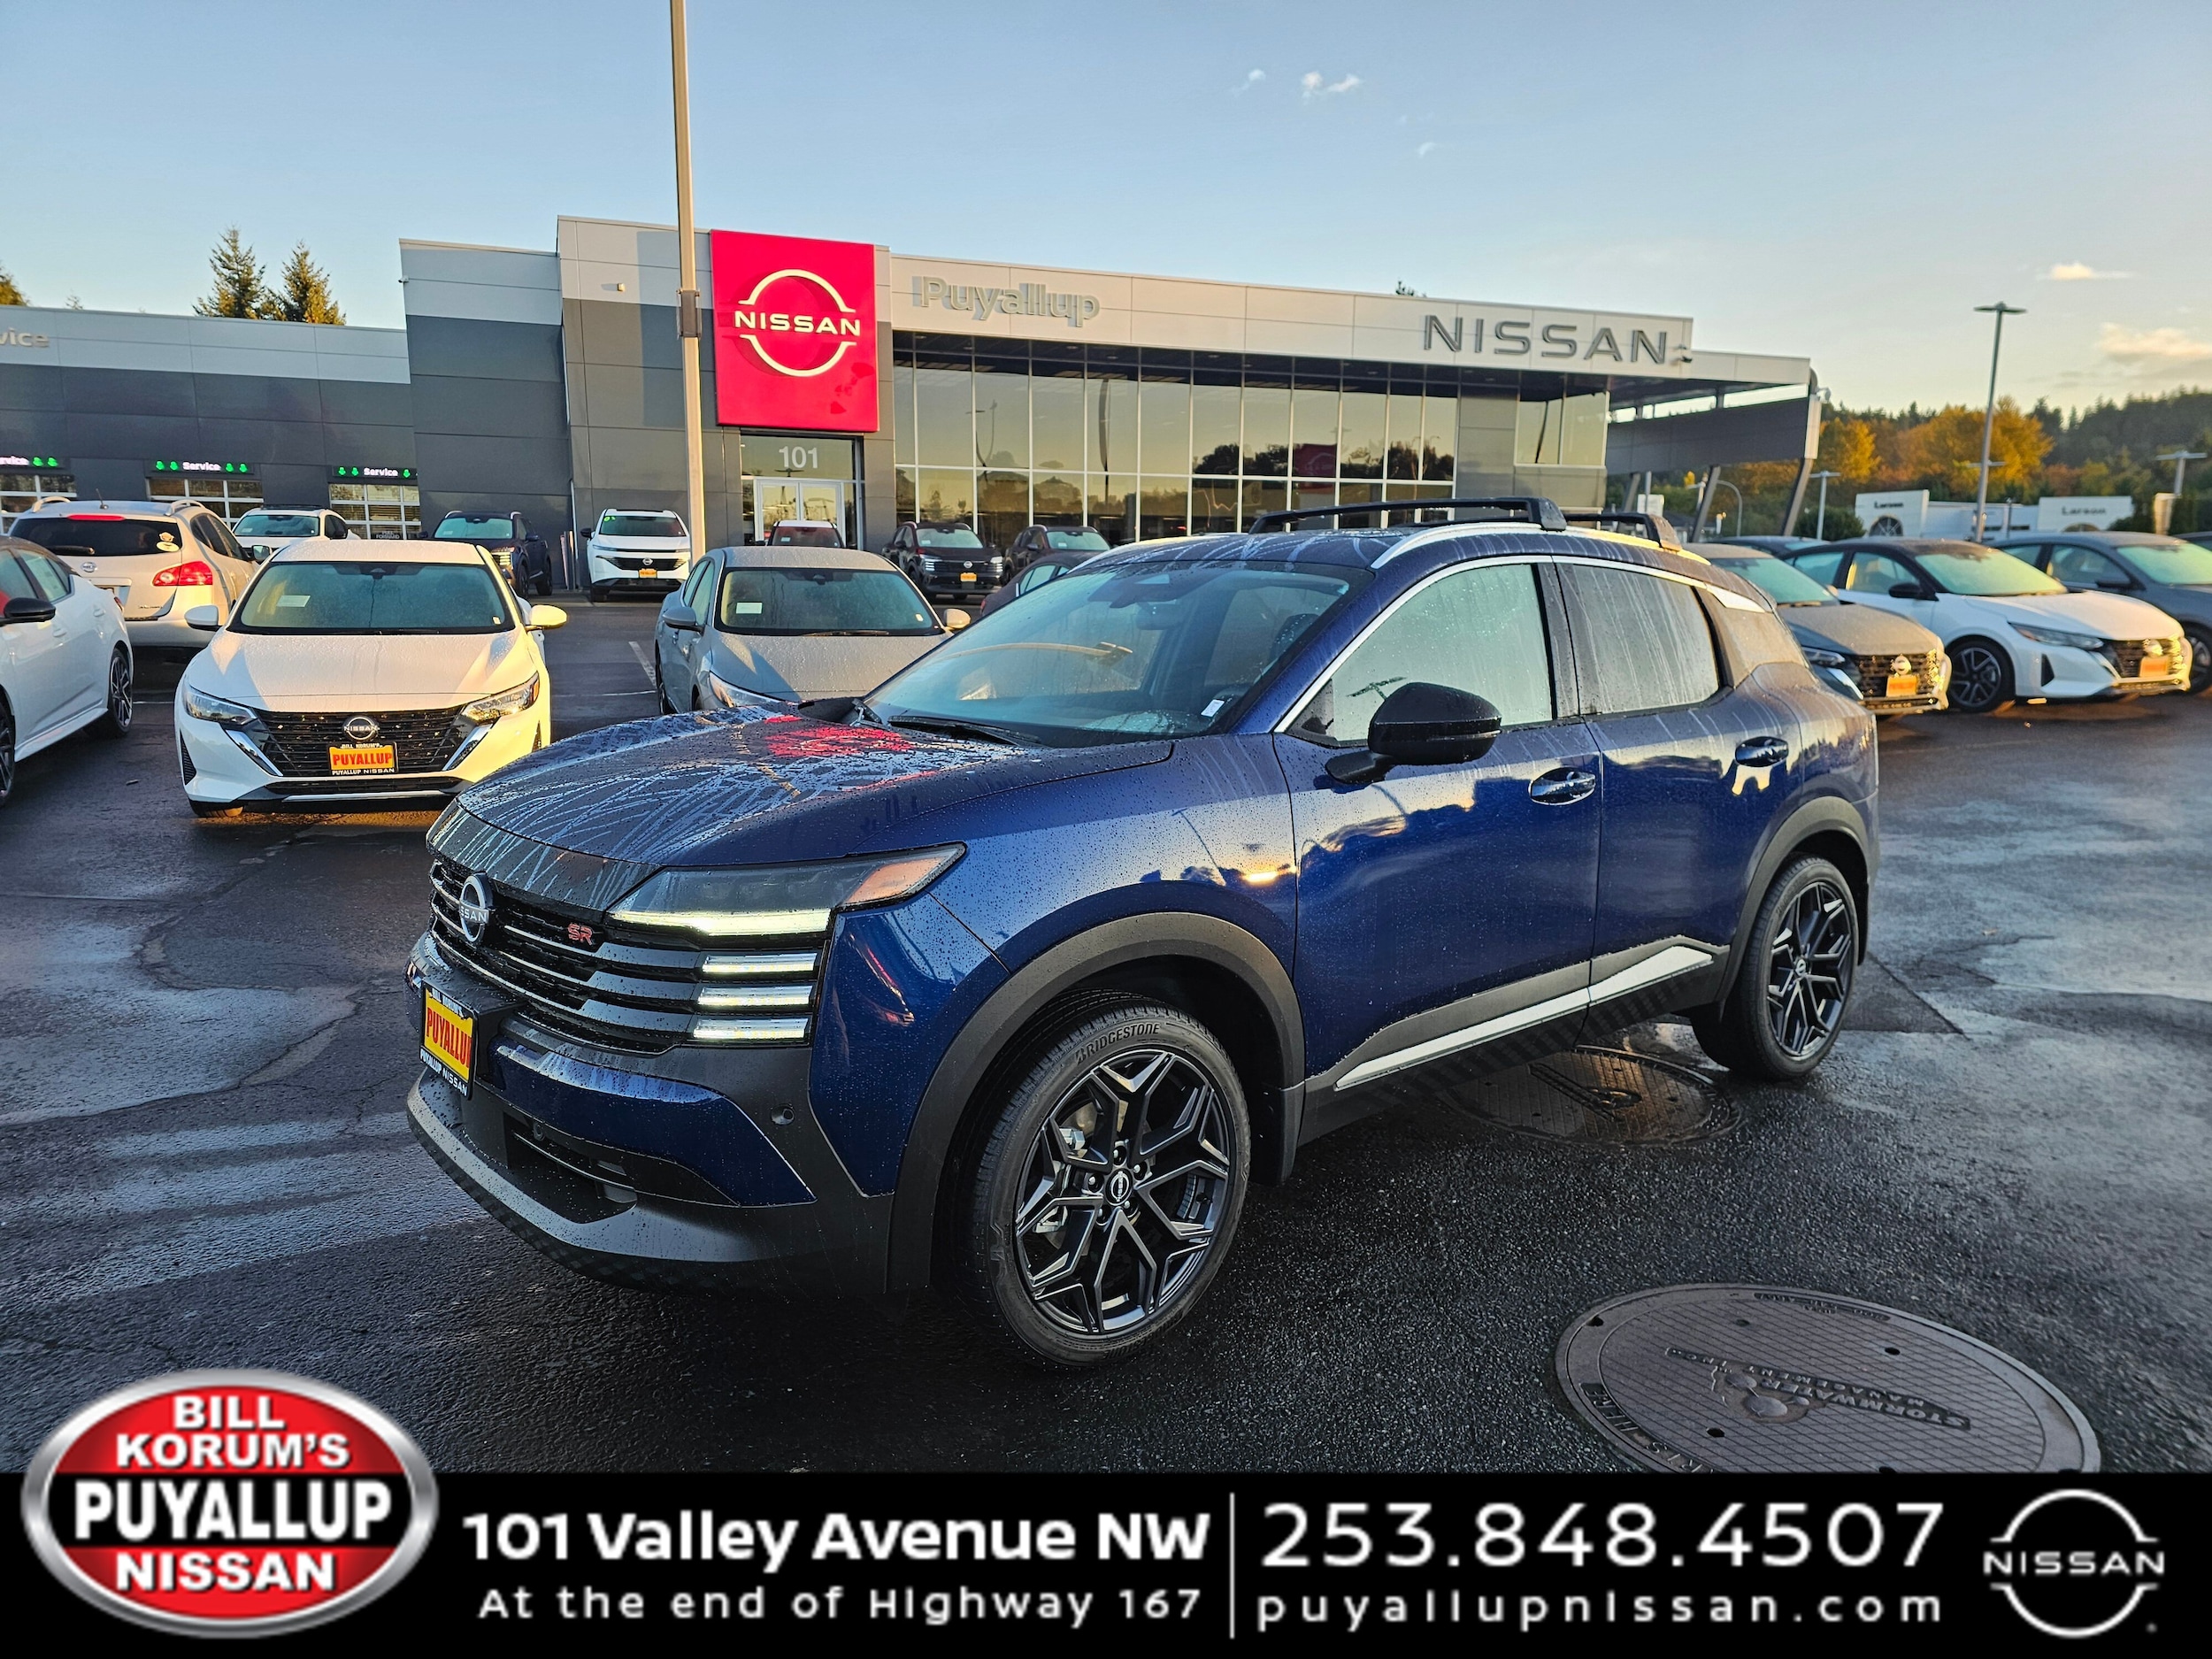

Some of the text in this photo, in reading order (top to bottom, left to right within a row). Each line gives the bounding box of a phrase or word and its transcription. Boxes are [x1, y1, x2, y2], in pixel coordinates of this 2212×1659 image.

[917, 276, 1102, 328] Puyallup
[735, 310, 861, 337] NISSAN
[1423, 314, 1668, 365] NISSAN
[182, 461, 221, 472] Service
[779, 445, 819, 470] 101
[364, 467, 399, 477] Service
[2062, 505, 2108, 516] Larson
[332, 752, 393, 766] PUYALLUP
[567, 922, 592, 946] SR
[1075, 1023, 1160, 1065] BRIDGESTONE
[420, 1048, 468, 1097] PUYALLUP NISSAN
[1747, 1365, 1925, 1407] MANAGEMENT
[1760, 1378, 1970, 1429] STORMWATER
